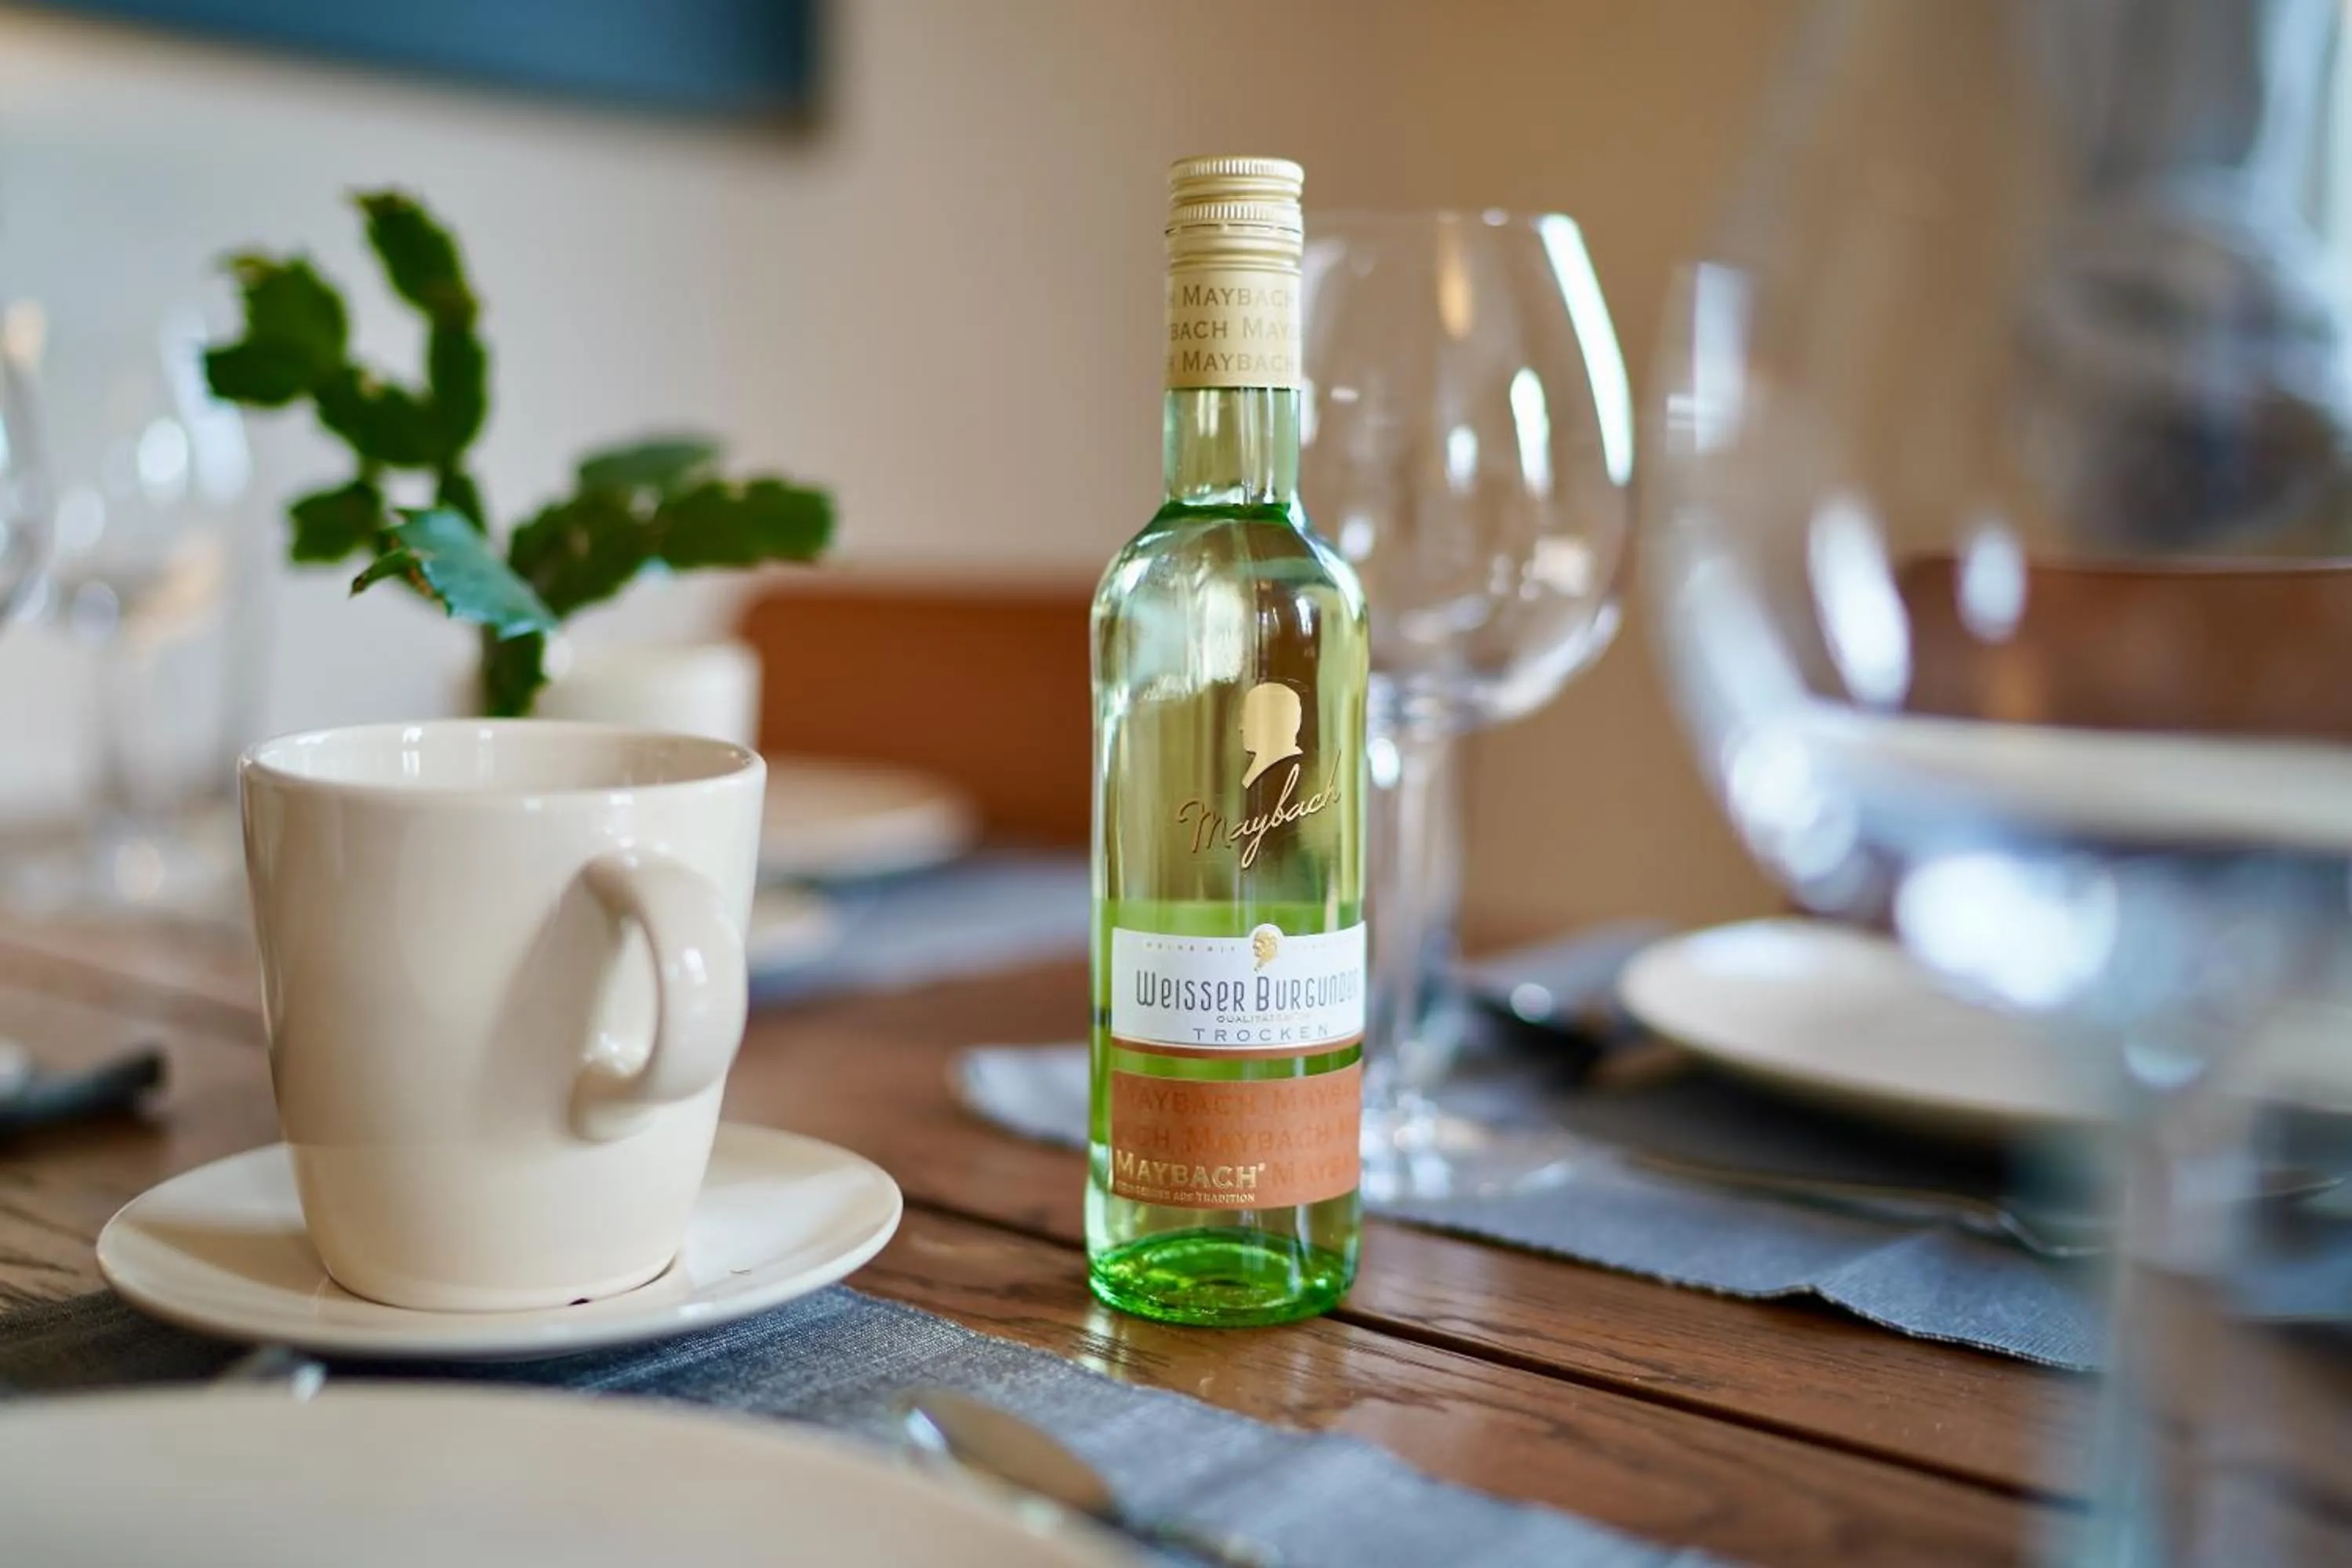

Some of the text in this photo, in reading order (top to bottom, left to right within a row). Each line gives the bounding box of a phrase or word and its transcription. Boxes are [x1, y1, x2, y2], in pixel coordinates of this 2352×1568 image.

[1178, 750, 1341, 869] Maybach
[1192, 1024, 1328, 1042] TROCKEN
[1116, 1148, 1257, 1189] MAYBACH
[1197, 1191, 1254, 1203] TRADITION
